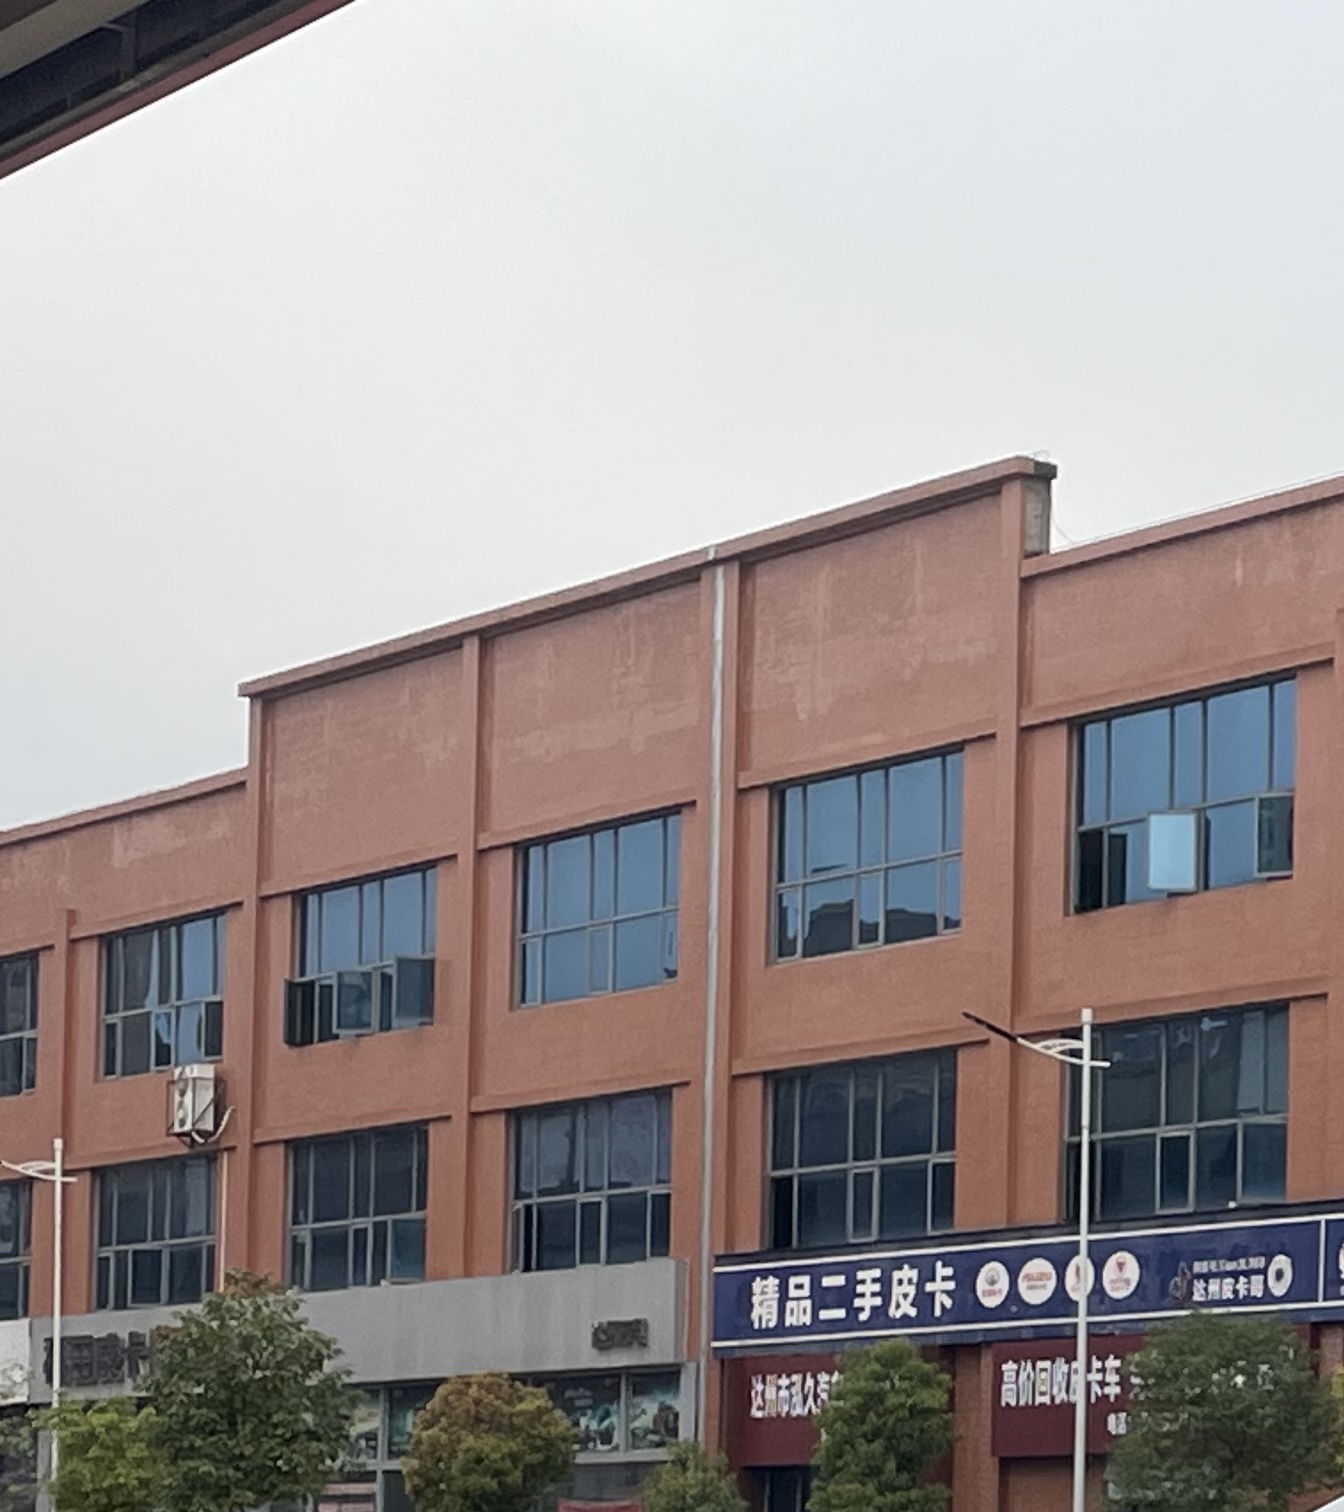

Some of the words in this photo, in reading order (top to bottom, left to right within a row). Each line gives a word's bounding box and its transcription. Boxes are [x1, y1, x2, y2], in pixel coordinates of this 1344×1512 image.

[750, 1260, 956, 1330] 精品二手皮卡
